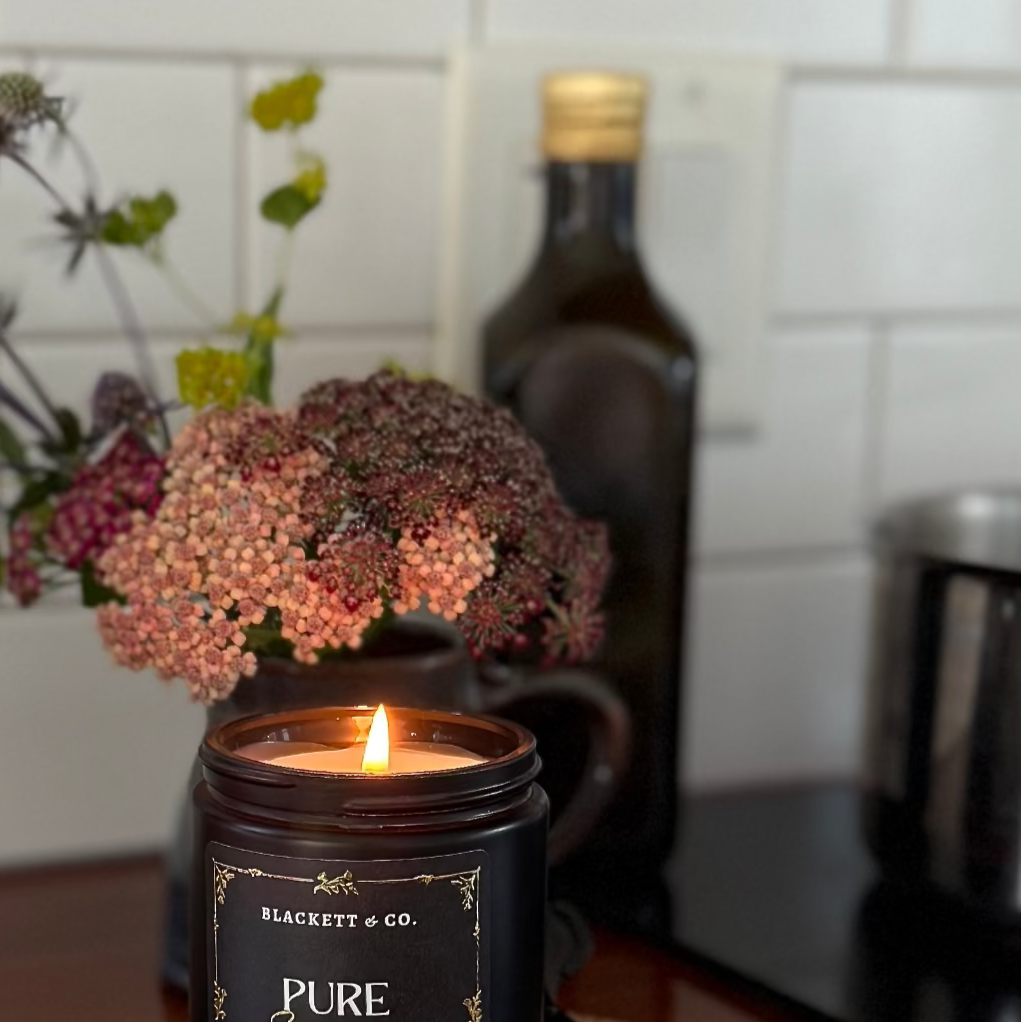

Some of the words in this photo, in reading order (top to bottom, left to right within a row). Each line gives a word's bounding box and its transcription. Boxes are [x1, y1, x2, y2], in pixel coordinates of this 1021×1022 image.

[262, 907, 357, 927] BLACKETT
[365, 915, 378, 928] &
[384, 913, 417, 927] CO.
[283, 977, 390, 1016] PURE
